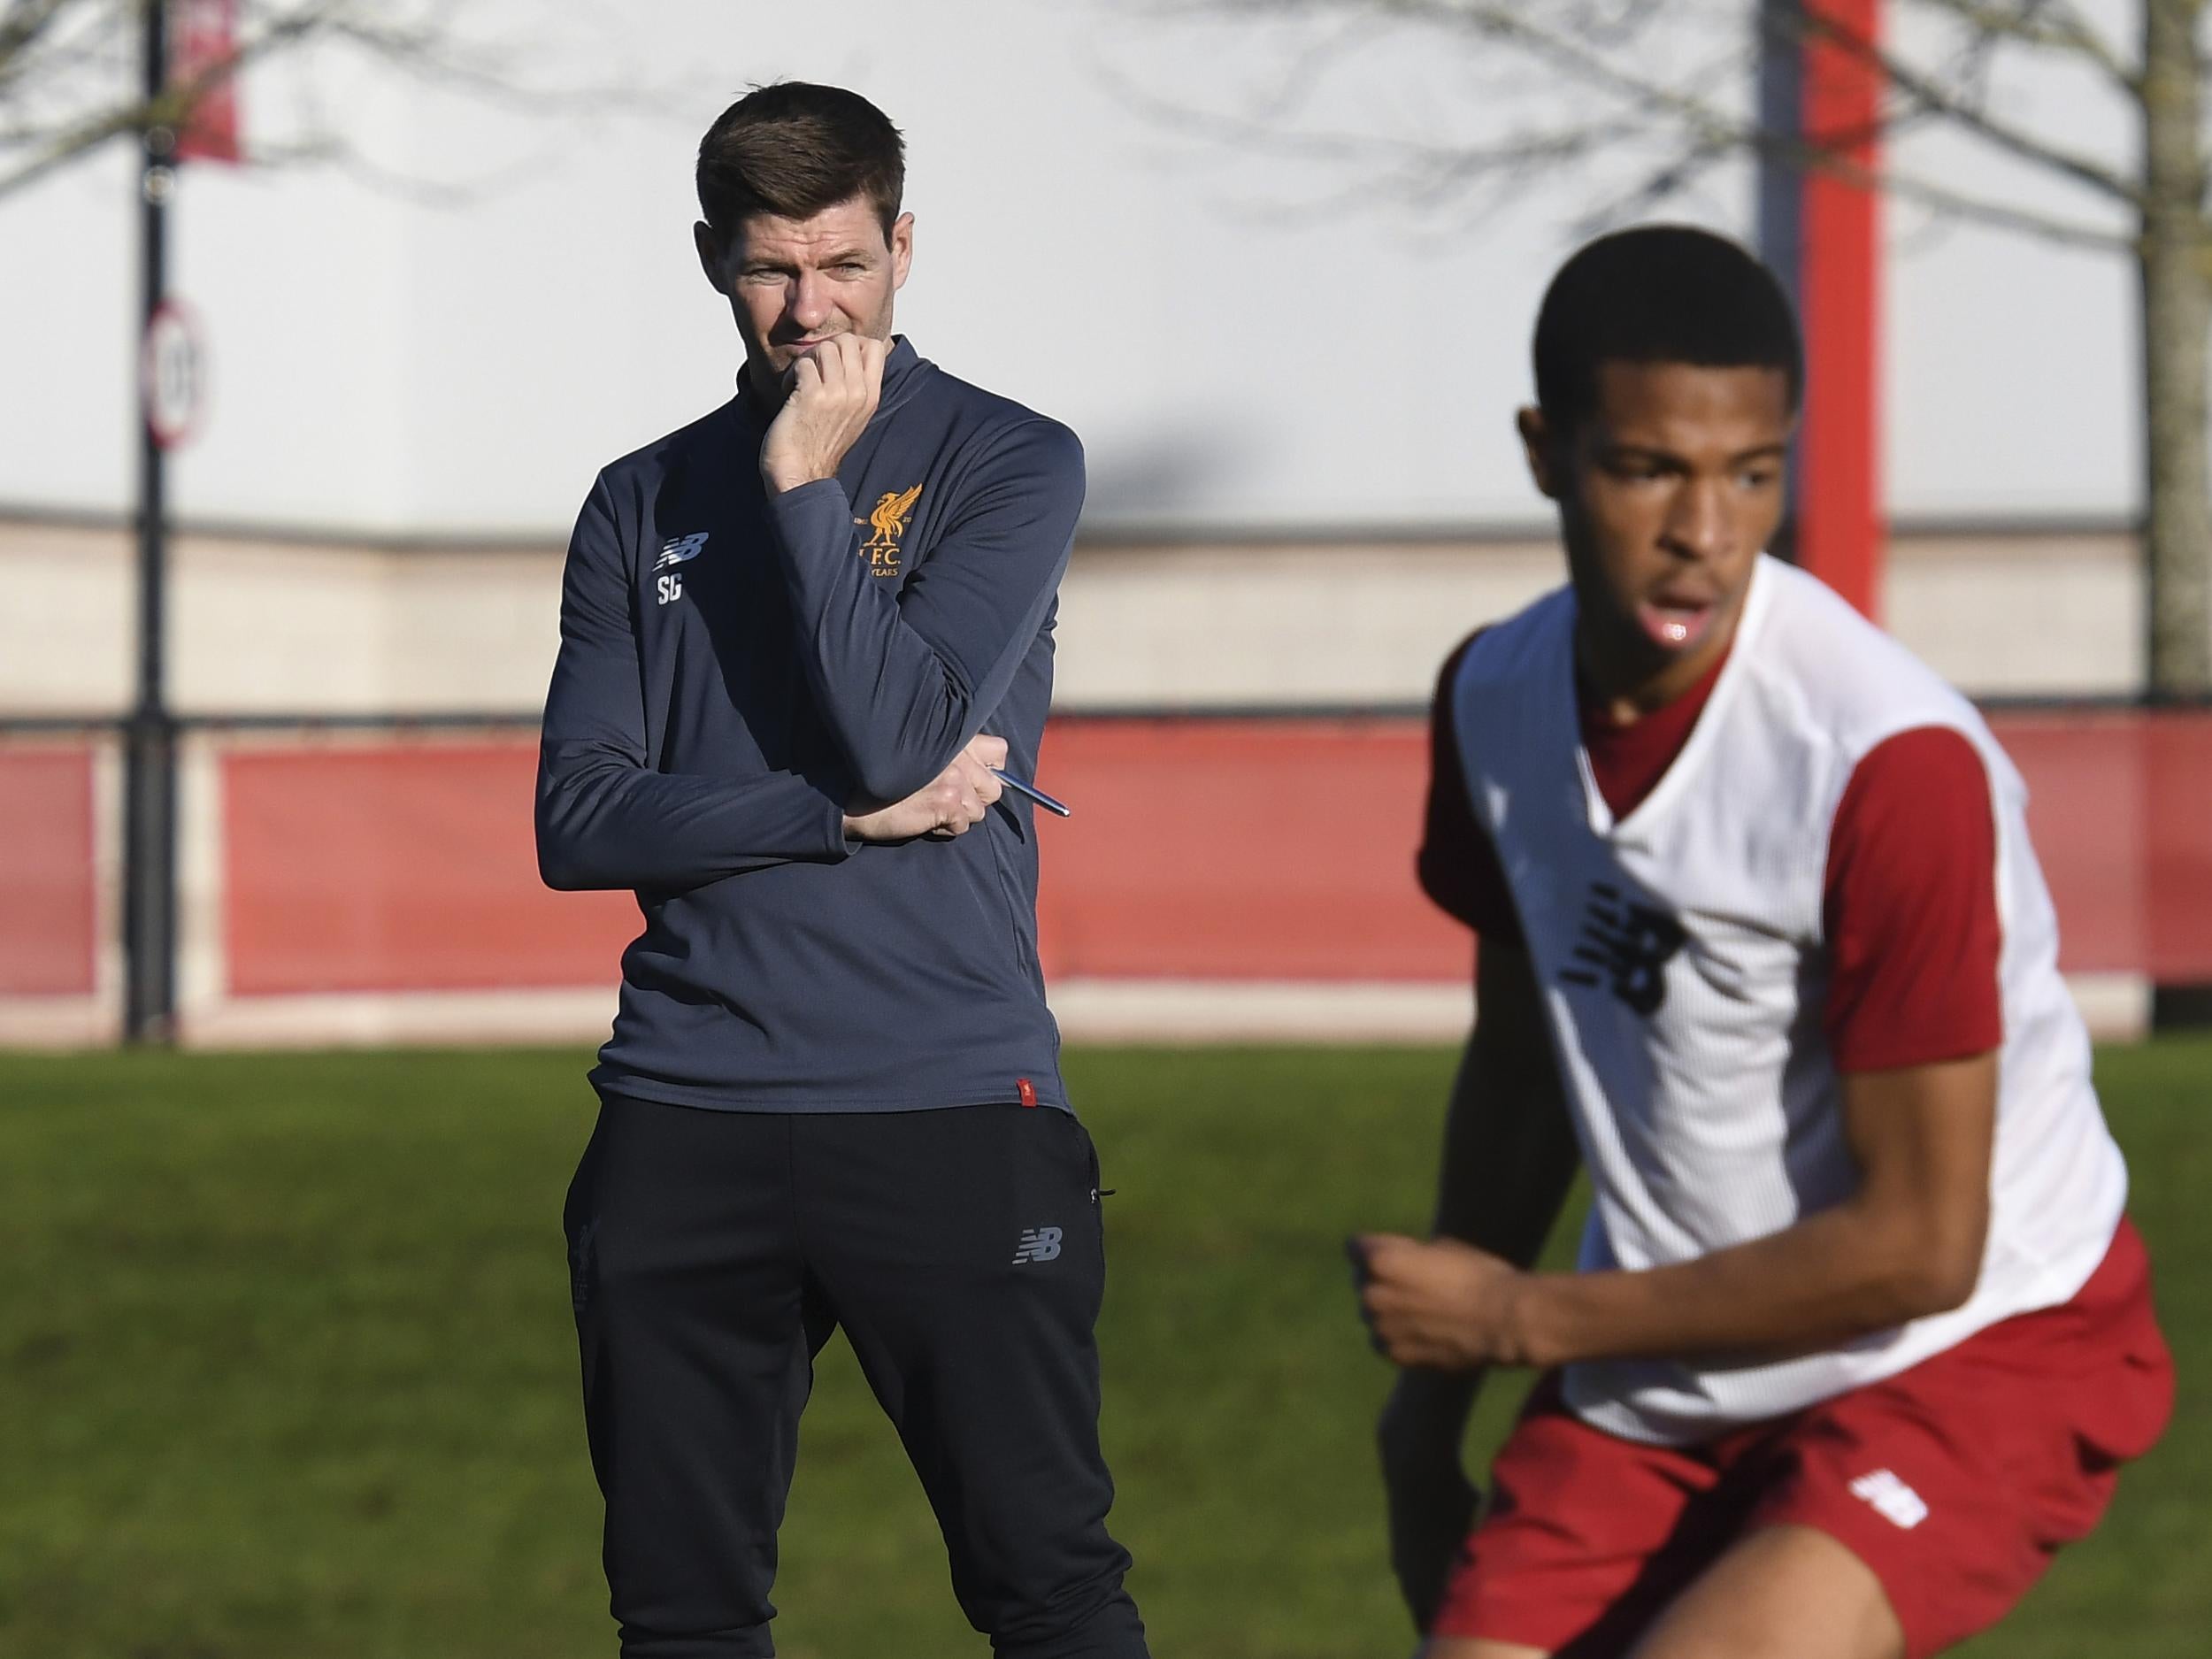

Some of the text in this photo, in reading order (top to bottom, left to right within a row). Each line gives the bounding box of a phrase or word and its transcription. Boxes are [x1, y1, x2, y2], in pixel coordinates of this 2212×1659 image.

[652, 533, 709, 572] NB
[657, 573, 682, 605] SG
[1012, 1227, 1063, 1264] NB
